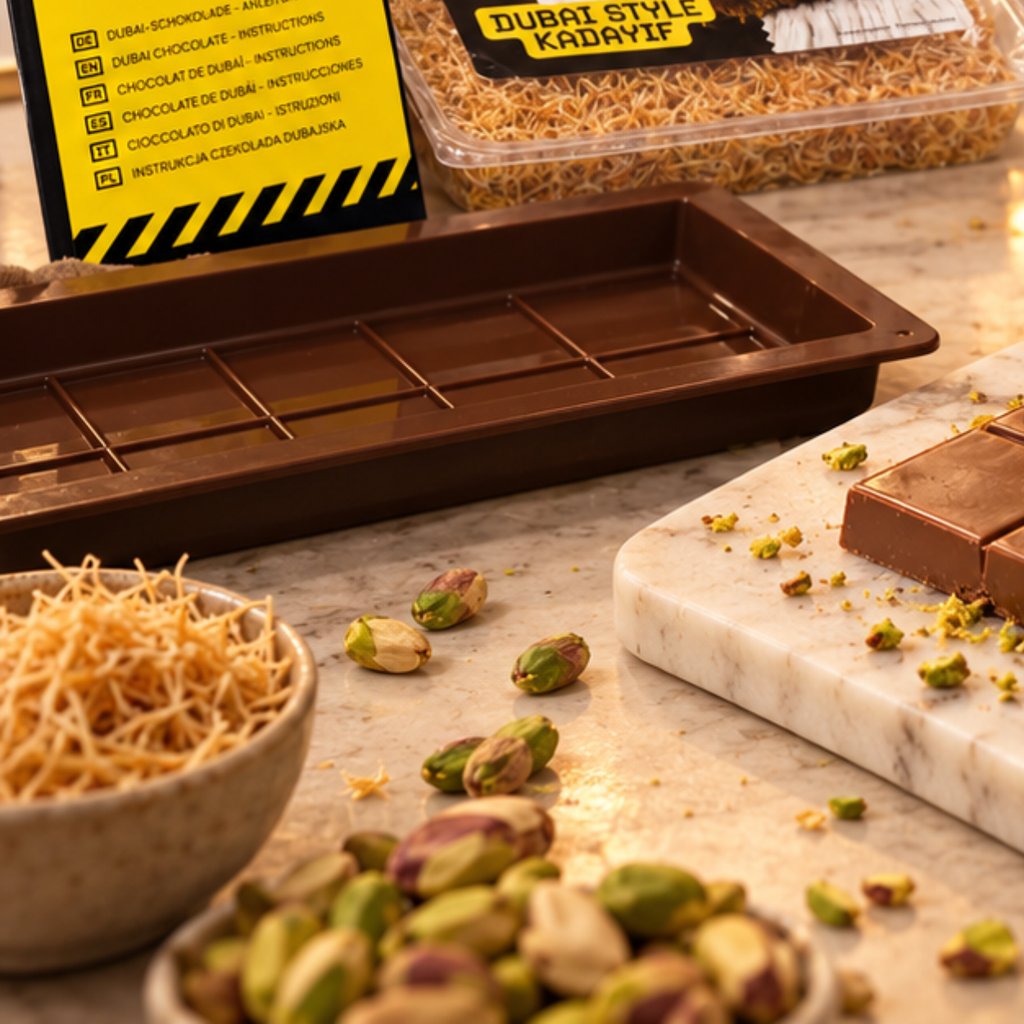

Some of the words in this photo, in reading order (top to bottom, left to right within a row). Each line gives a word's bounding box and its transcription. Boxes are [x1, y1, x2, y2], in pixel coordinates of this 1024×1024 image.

[490, 5, 597, 33] DUBAI
[153, 33, 228, 60] CHOCOLATE
[534, 22, 673, 52] KADAYIF
[117, 69, 186, 96] CHOCOLAT
[188, 65, 205, 81] DE
[122, 94, 199, 124] CHOCOLATE
[200, 91, 218, 105] DE
[127, 121, 211, 151] CIOCCOLATO
[212, 119, 226, 132] DI
